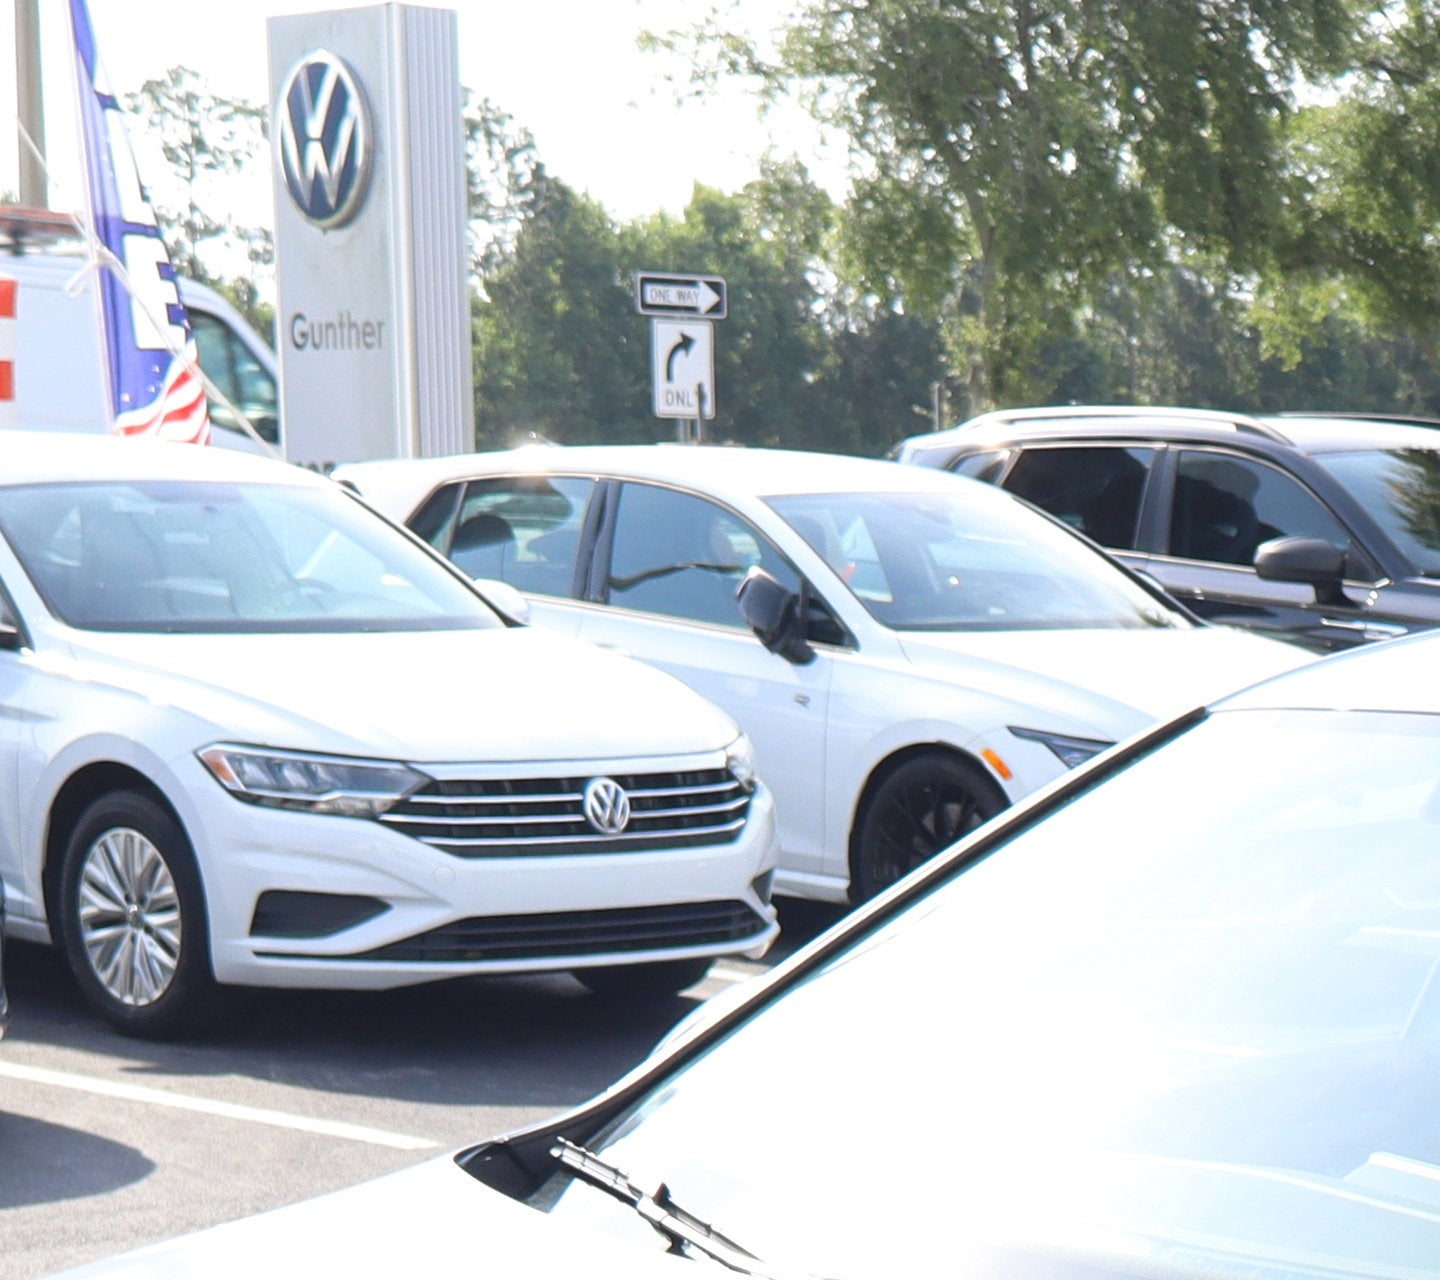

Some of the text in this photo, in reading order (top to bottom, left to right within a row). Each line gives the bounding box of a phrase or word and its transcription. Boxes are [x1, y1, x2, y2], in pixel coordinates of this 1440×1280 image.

[650, 288, 700, 304] ONE WAY
[289, 311, 385, 351] Gunther
[665, 389, 701, 409] ONL
